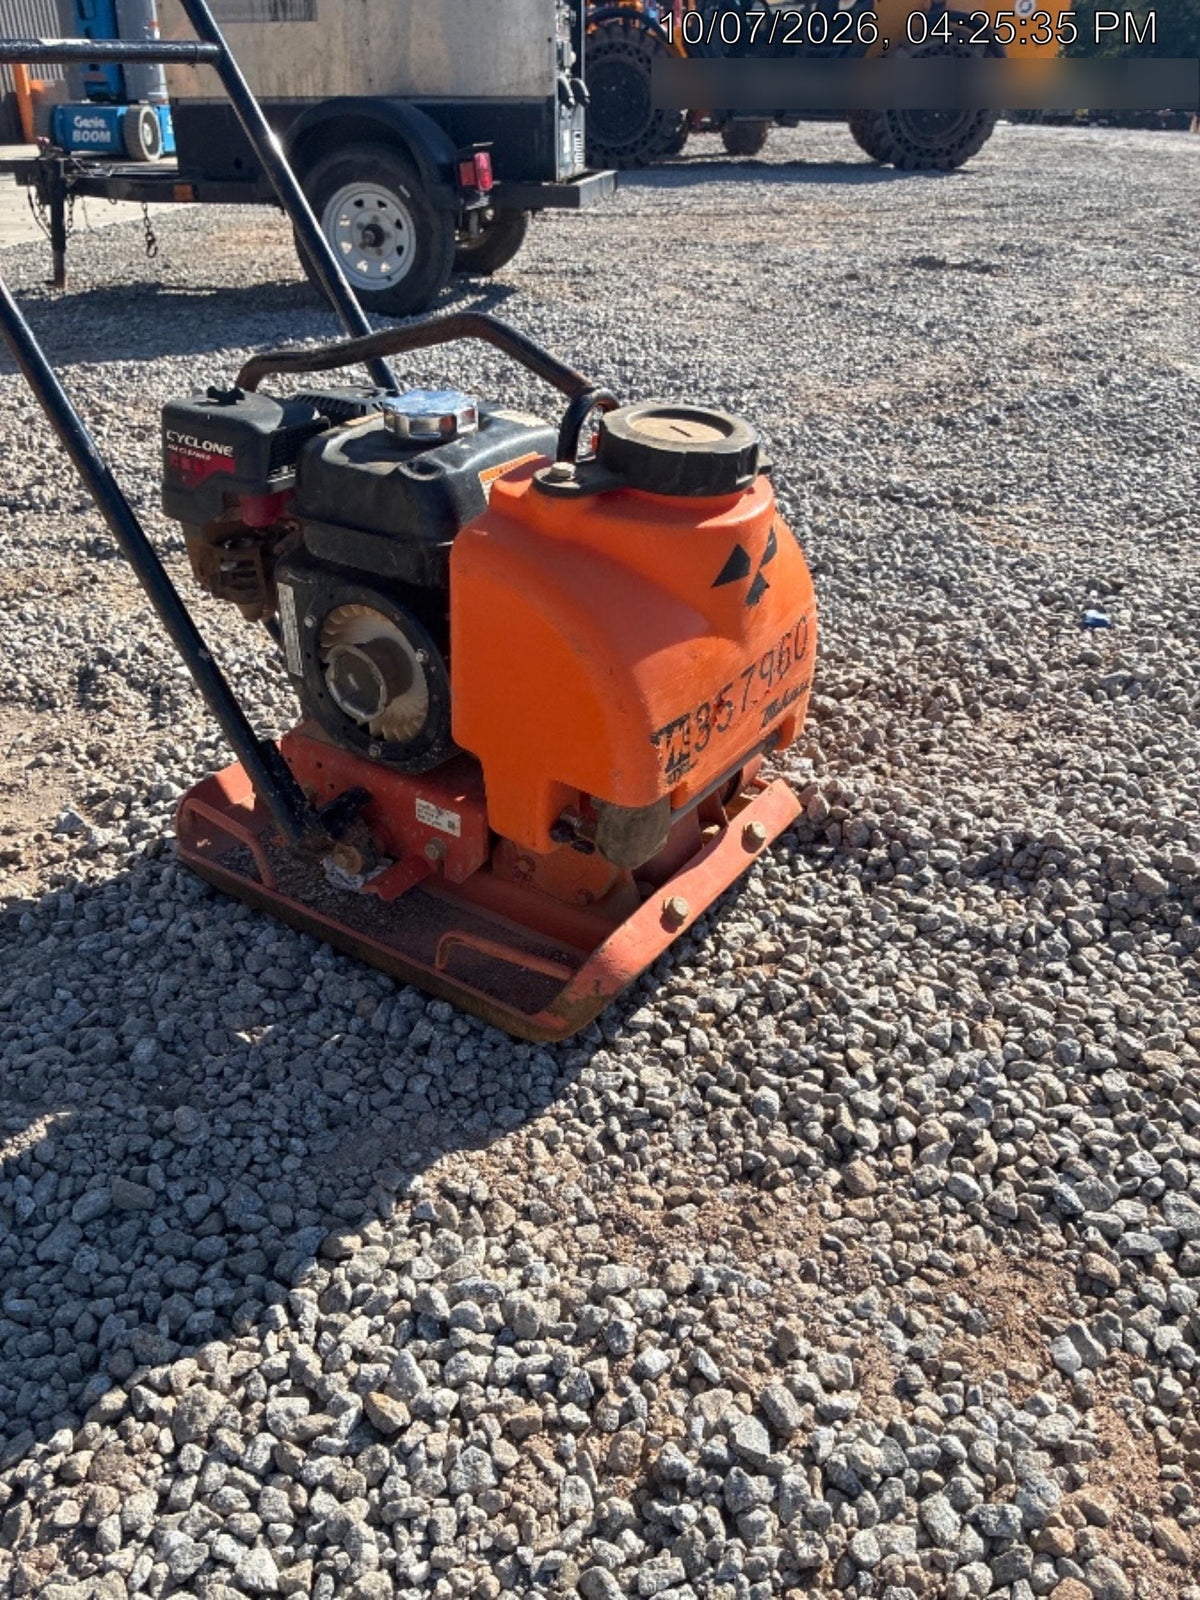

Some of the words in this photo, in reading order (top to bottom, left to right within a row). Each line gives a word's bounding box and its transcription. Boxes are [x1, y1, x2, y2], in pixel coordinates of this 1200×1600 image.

[73, 115, 107, 129] Genie
[72, 130, 111, 143] BOOM
[166, 430, 234, 457] CYCLONE
